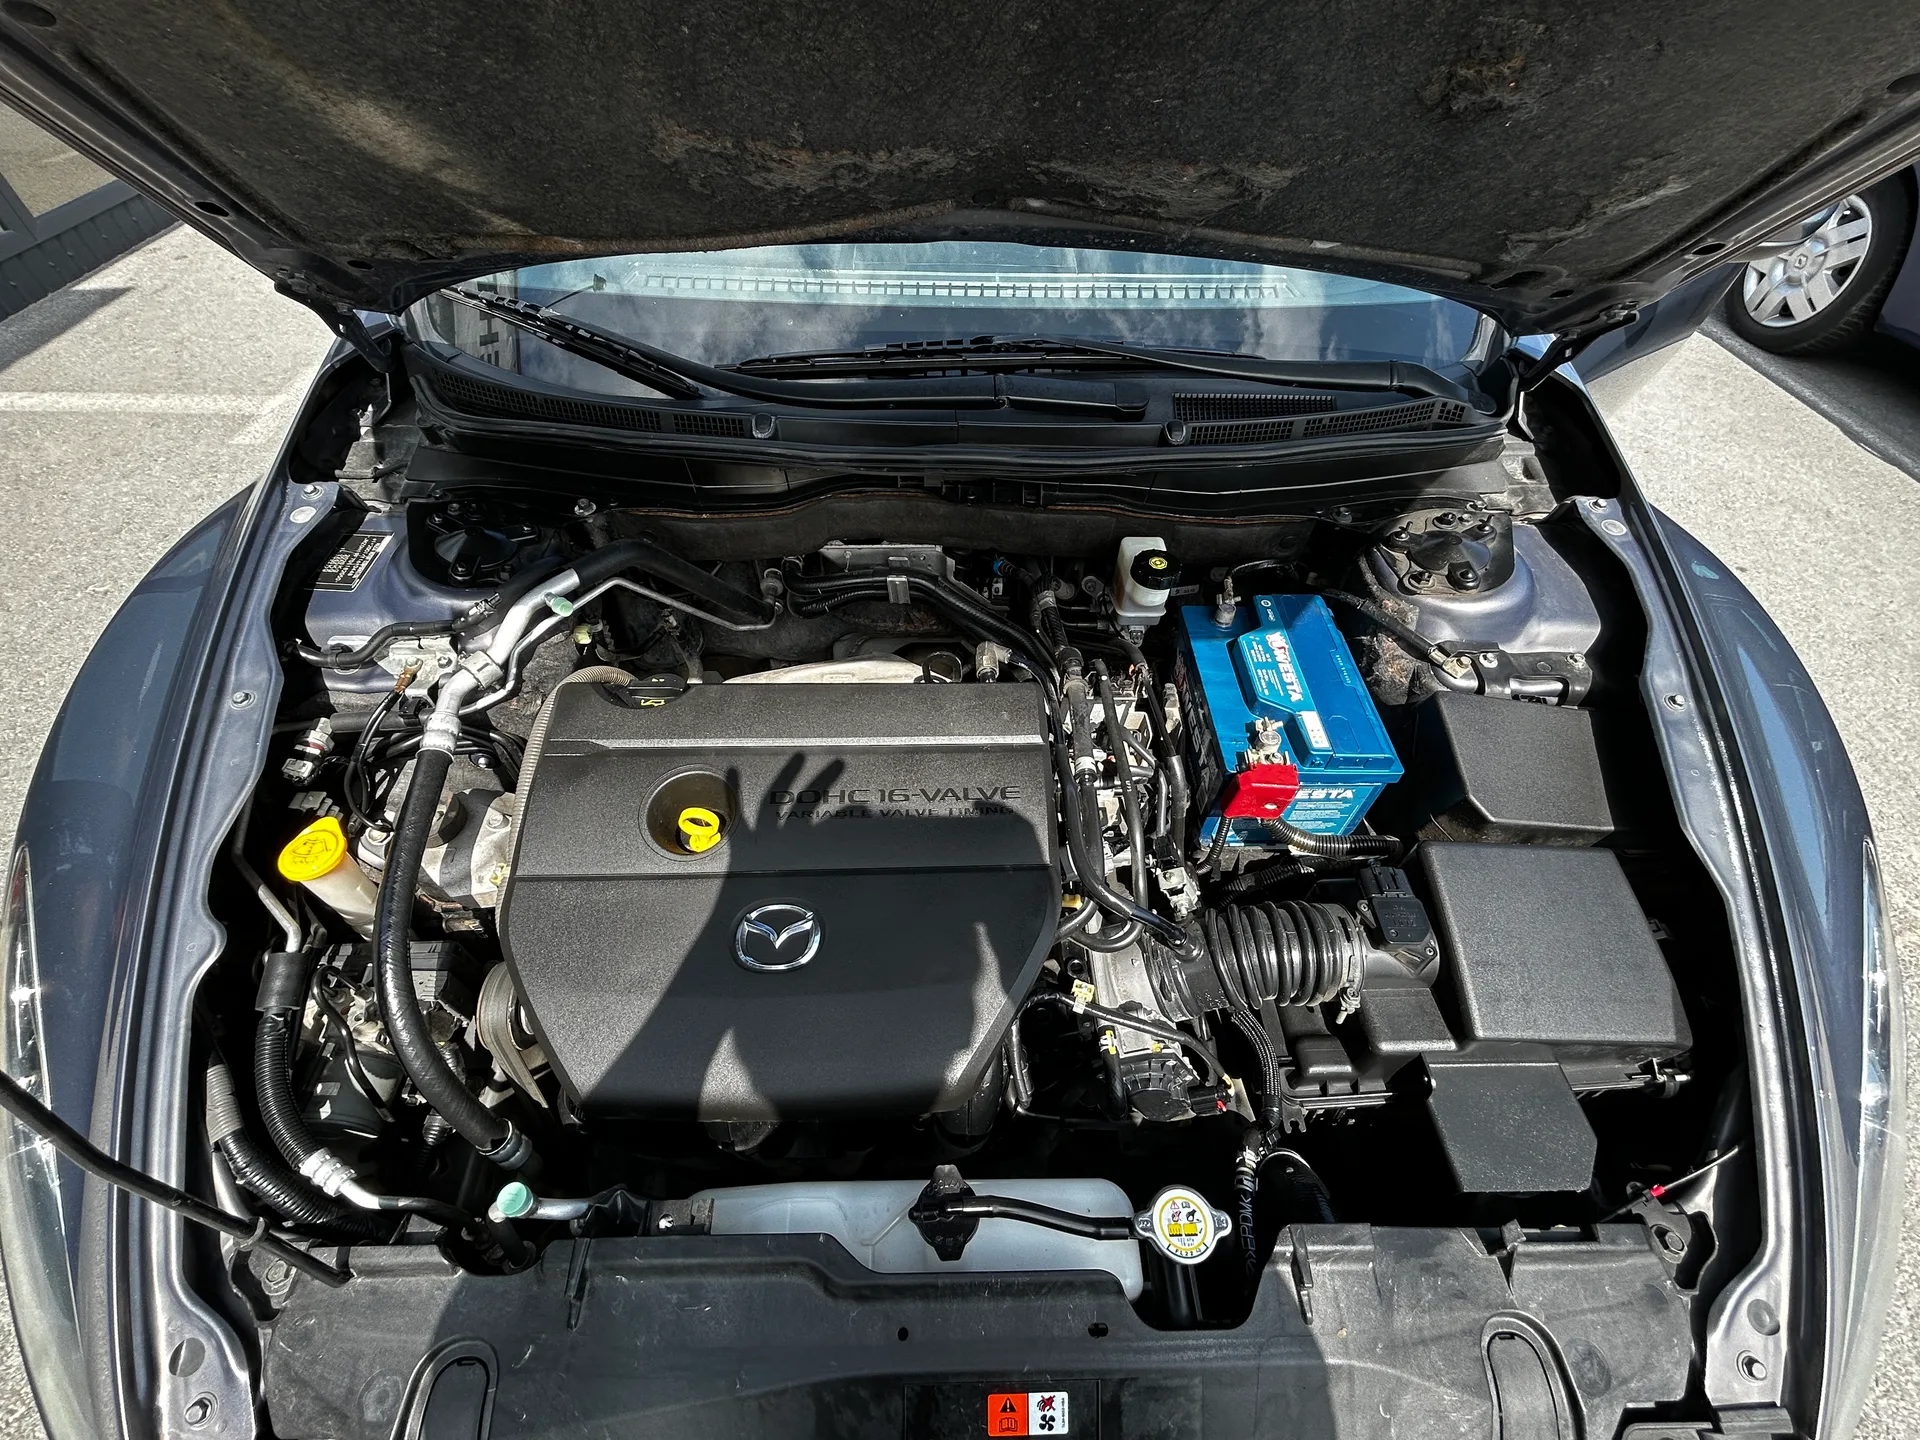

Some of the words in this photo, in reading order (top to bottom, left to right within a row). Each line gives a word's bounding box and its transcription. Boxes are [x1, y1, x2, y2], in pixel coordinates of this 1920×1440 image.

[1275, 649, 1303, 702] WESTA
[769, 789, 871, 805] DOHC
[878, 785, 1021, 804] 16-VALVE
[1294, 789, 1354, 799] ESTA
[775, 808, 873, 821] VARIABLE
[879, 807, 940, 819] VALVE
[948, 805, 1014, 818] TIMING
[1175, 1248, 1194, 1256] FL22
